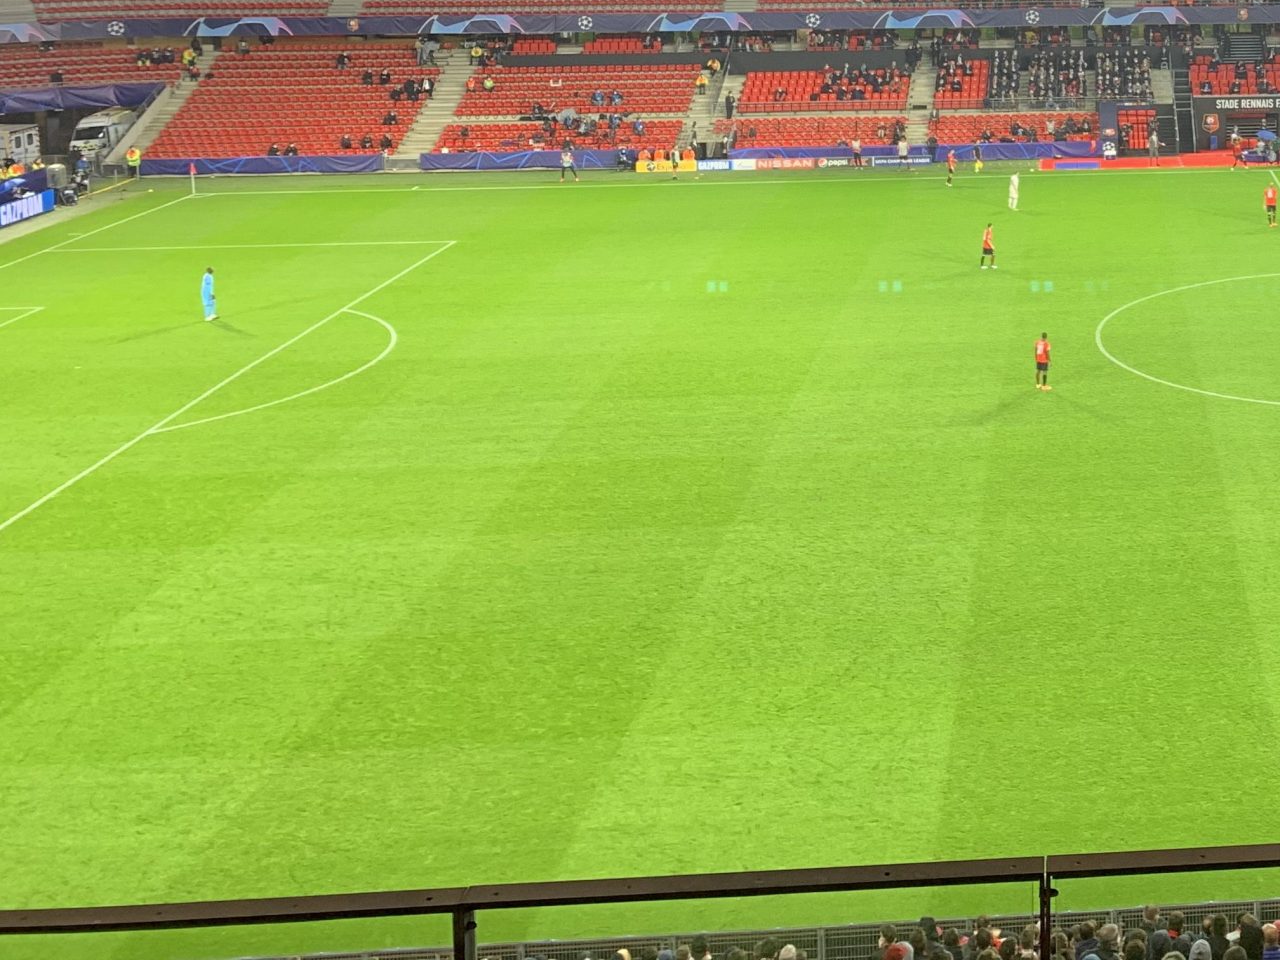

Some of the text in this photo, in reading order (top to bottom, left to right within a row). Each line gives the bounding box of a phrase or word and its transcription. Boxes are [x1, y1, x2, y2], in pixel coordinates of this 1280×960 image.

[1215, 99, 1239, 109] STADE
[1241, 98, 1274, 109] RENNAIS
[758, 159, 812, 169] NISSAN
[828, 158, 848, 167] pepsi
[0, 193, 43, 227] GAZPROM
